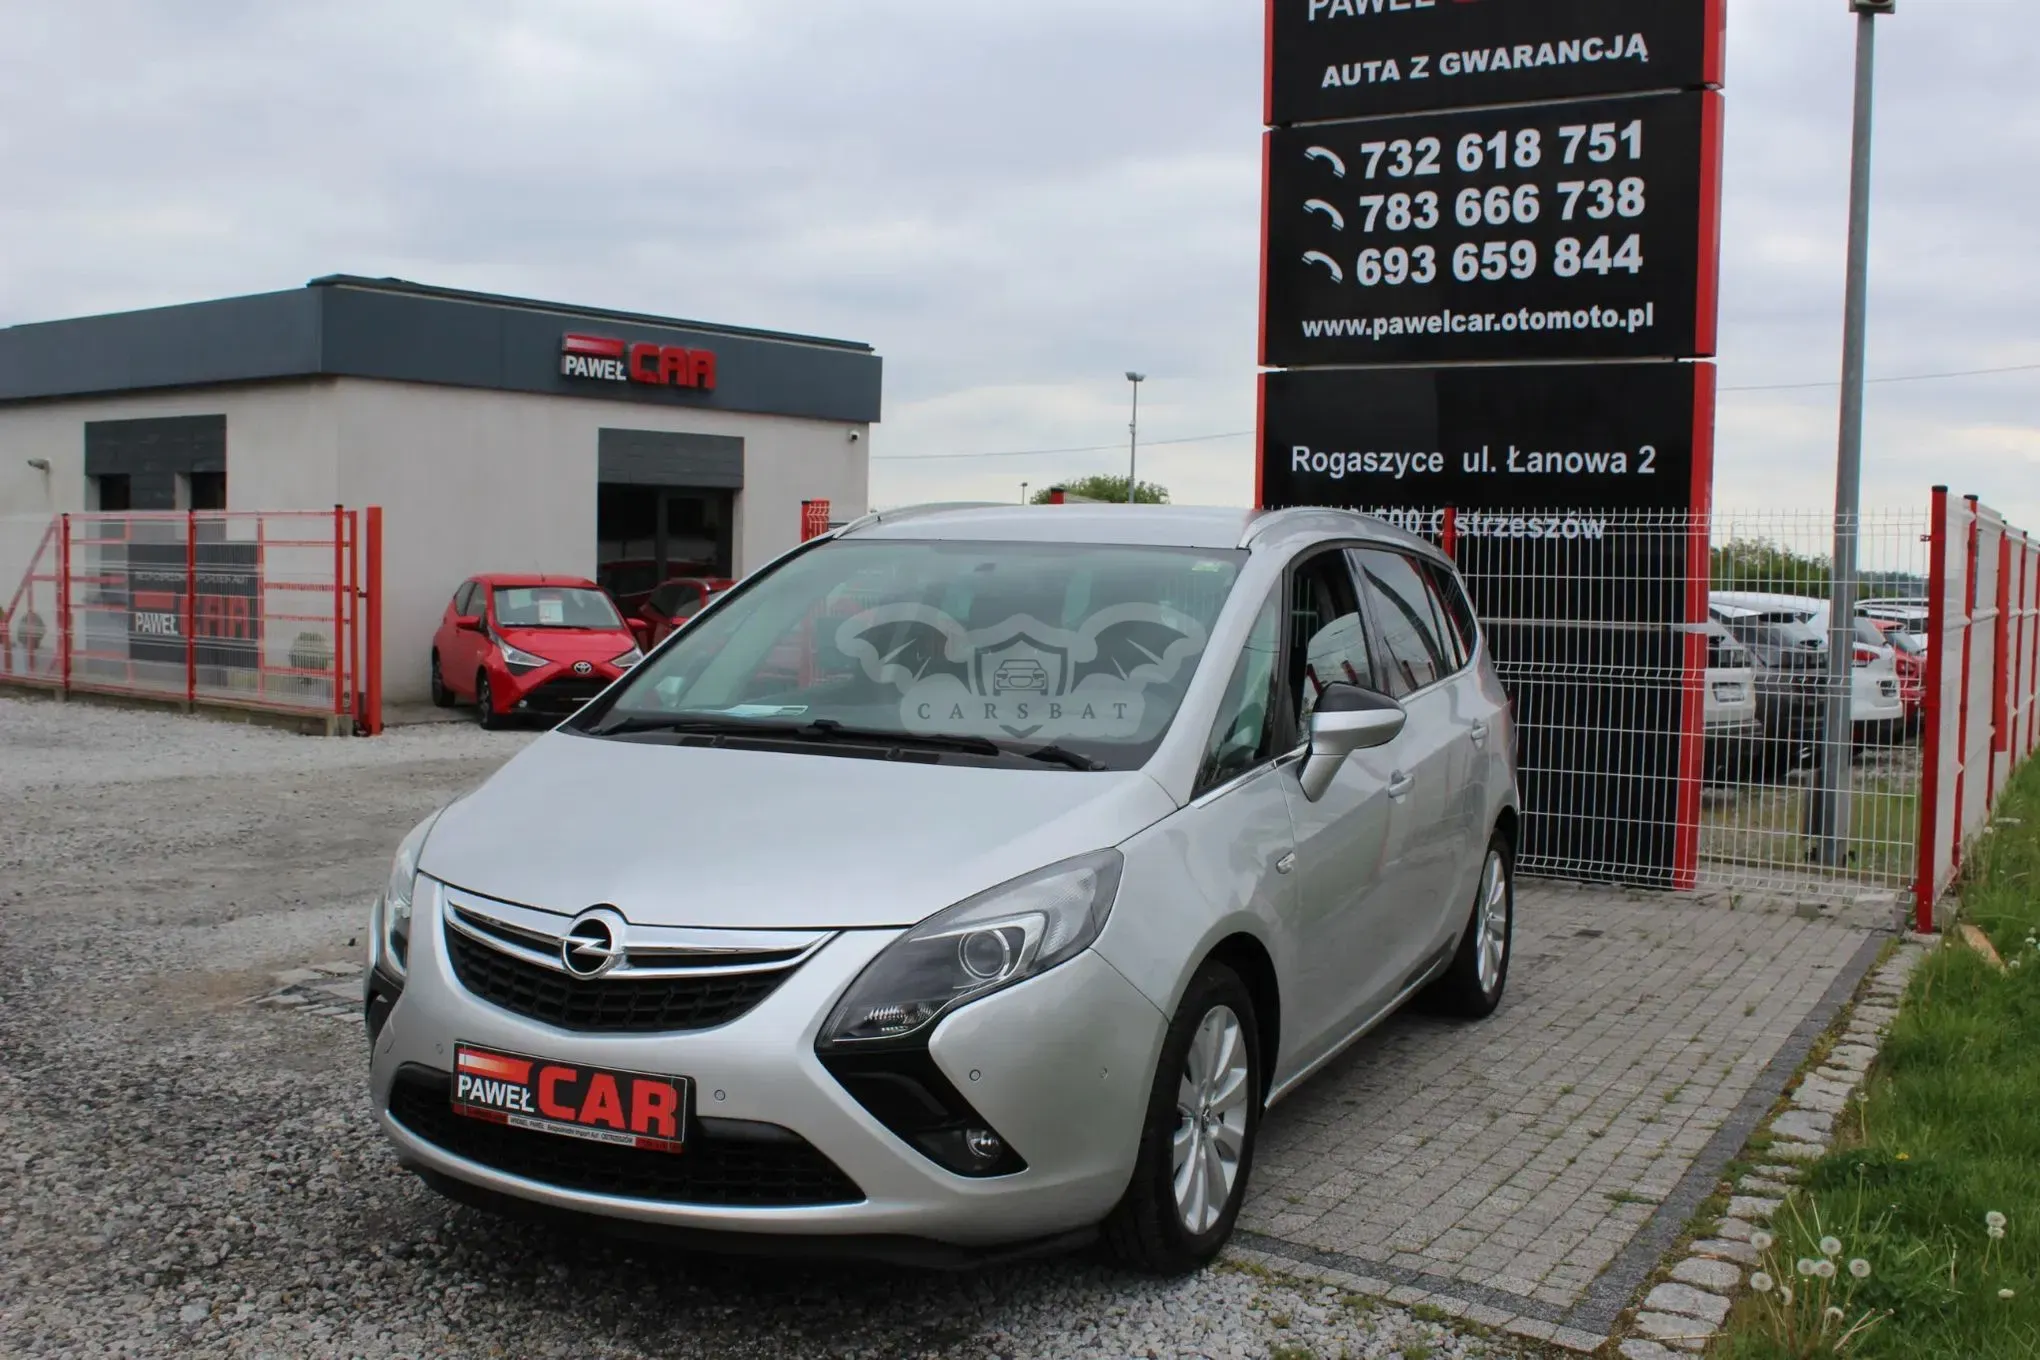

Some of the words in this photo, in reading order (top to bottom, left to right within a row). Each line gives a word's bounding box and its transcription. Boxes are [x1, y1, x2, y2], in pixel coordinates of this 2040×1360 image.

[1321, 59, 1401, 88] AUTA
[1409, 56, 1430, 79] Z
[1439, 33, 1649, 76] GWARANCJĄ
[1360, 137, 1441, 179] 732
[1456, 129, 1542, 172] 618
[1558, 120, 1643, 164] 751
[1358, 191, 1440, 233] 783
[1455, 184, 1540, 227] 666
[1556, 177, 1646, 220] 738
[1356, 245, 1437, 286] 693
[1452, 239, 1537, 281] 659
[1553, 234, 1643, 277] 844
[1302, 302, 1654, 339] www.pawelcar.otomoto.pl
[563, 355, 627, 381] PAWEŁ
[629, 342, 717, 389] CAR
[1291, 445, 1445, 479] Rogaszyce
[1462, 446, 1497, 473] ul.
[1506, 445, 1628, 474] Łanowa
[1637, 445, 1656, 474] 2
[457, 1074, 535, 1113] PAWEŁ
[538, 1066, 678, 1138] CAR
